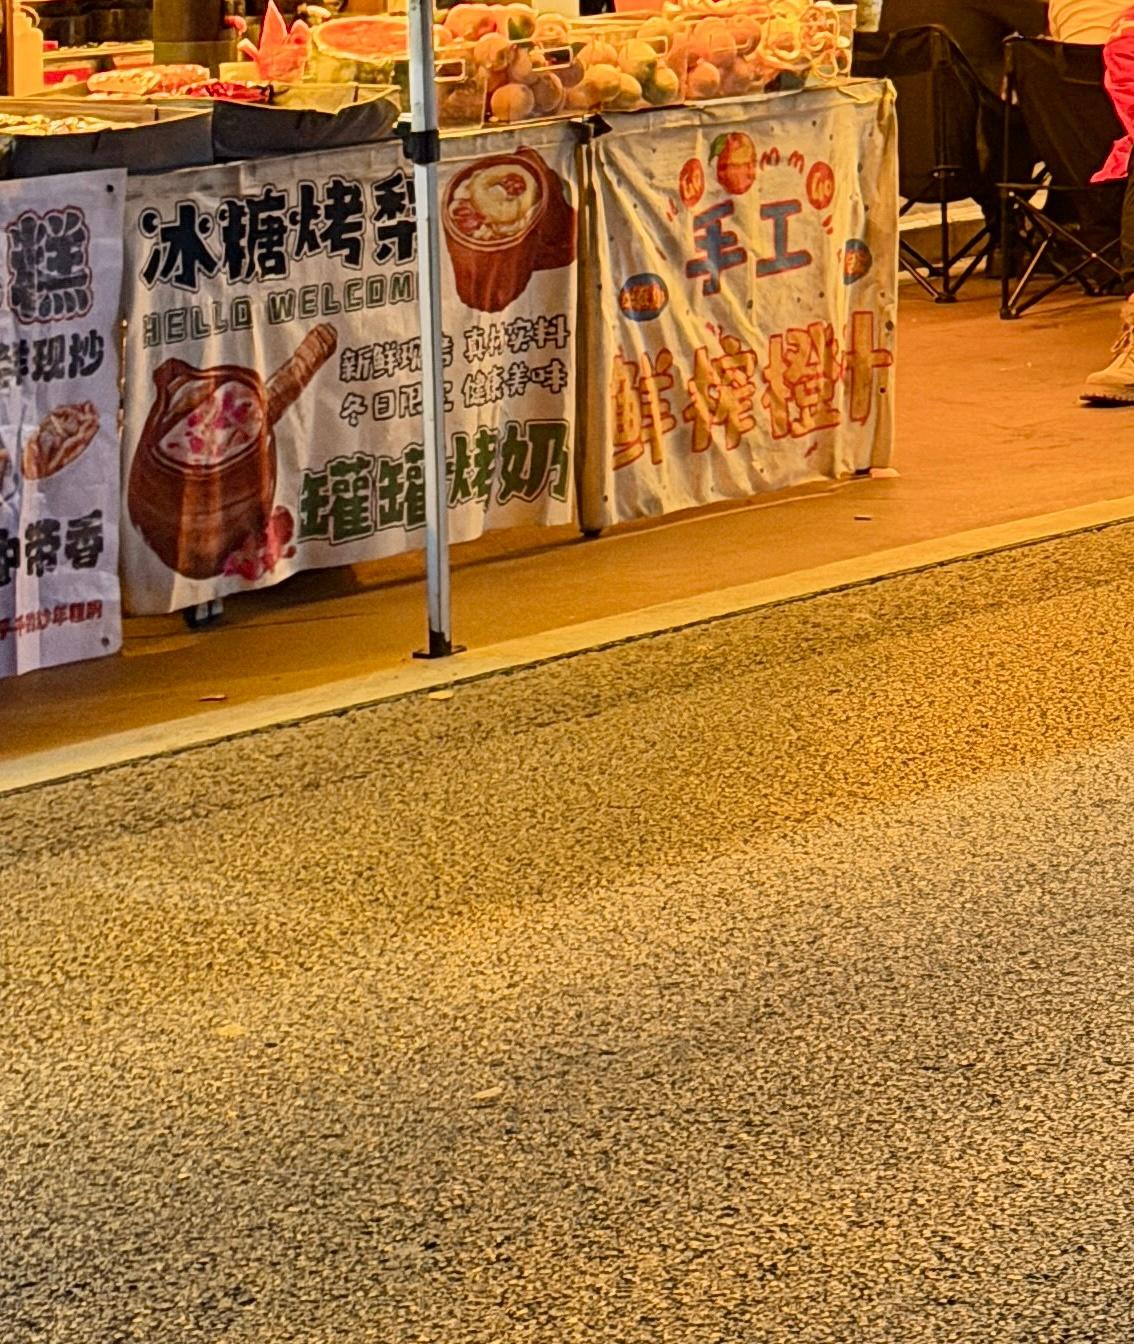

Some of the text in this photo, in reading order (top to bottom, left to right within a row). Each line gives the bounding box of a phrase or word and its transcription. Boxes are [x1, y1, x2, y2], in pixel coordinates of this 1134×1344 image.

[139, 168, 417, 291] 冰糖烤梨
[685, 198, 812, 297] 手工
[142, 272, 419, 348] HELLO WELCOM
[461, 358, 569, 408] 健康美味
[297, 418, 571, 545] 罐罐烤奶
